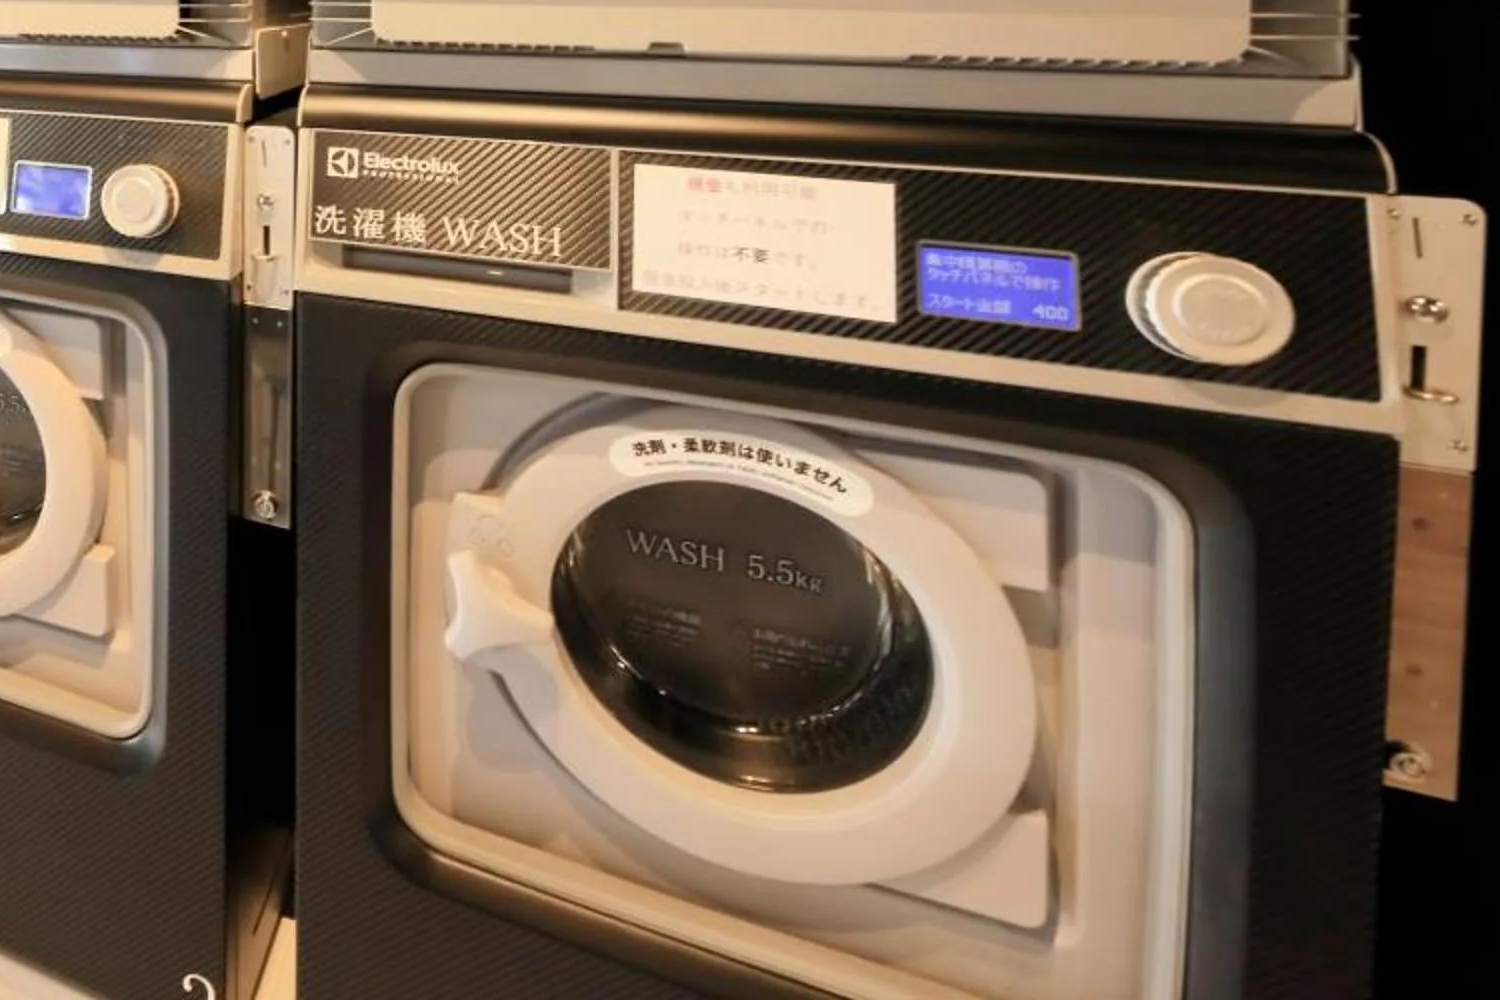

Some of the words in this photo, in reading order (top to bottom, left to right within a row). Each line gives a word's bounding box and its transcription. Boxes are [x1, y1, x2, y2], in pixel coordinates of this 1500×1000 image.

[363, 151, 460, 176] Electrolux
[315, 204, 427, 243] 洗濯機
[441, 215, 563, 257] WASH
[1031, 303, 1070, 321] 400
[632, 437, 848, 494] 洗剤・柔軟剤は使いません
[625, 528, 726, 573] WASH
